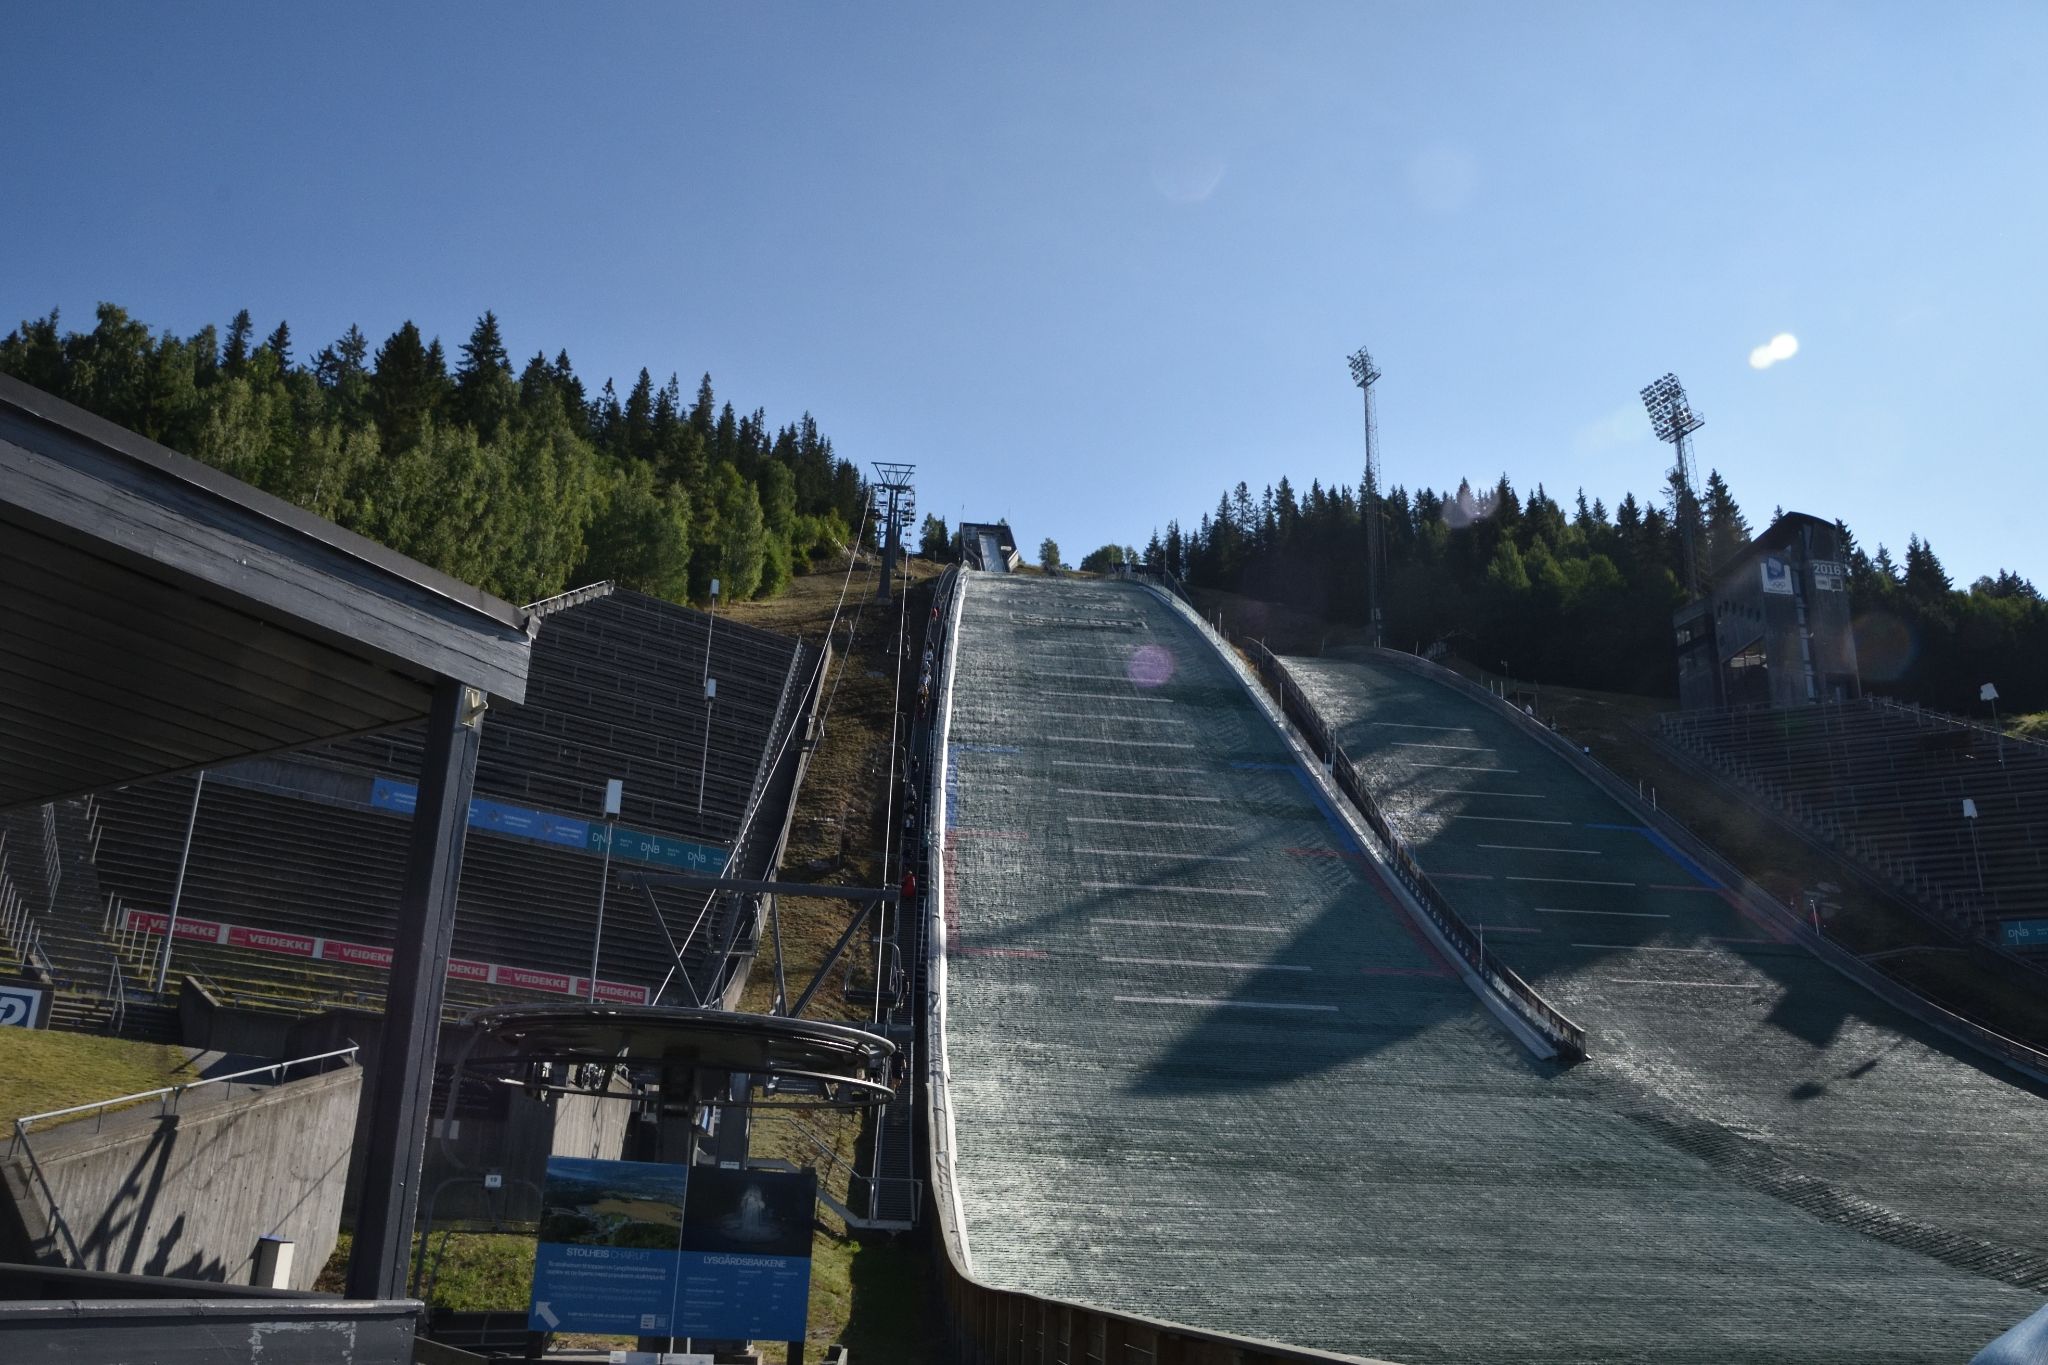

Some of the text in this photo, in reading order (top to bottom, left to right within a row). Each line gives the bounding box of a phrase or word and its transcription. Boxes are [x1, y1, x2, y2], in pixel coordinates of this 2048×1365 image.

[1813, 563, 1841, 575] 2016
[640, 834, 660, 862] DNB
[687, 844, 706, 871] DNB
[150, 918, 216, 937] VEDEKKE
[250, 933, 312, 951] VEIDEKKE
[343, 947, 393, 963] VEIDEKK
[449, 963, 487, 976] DEKKE
[514, 972, 568, 989] VEIDEKKE
[594, 985, 644, 1000] VEIDEKKE
[566, 1247, 610, 1258] STOLHEIS
[703, 1253, 787, 1268] LYSGÅRDSBAKKENE
